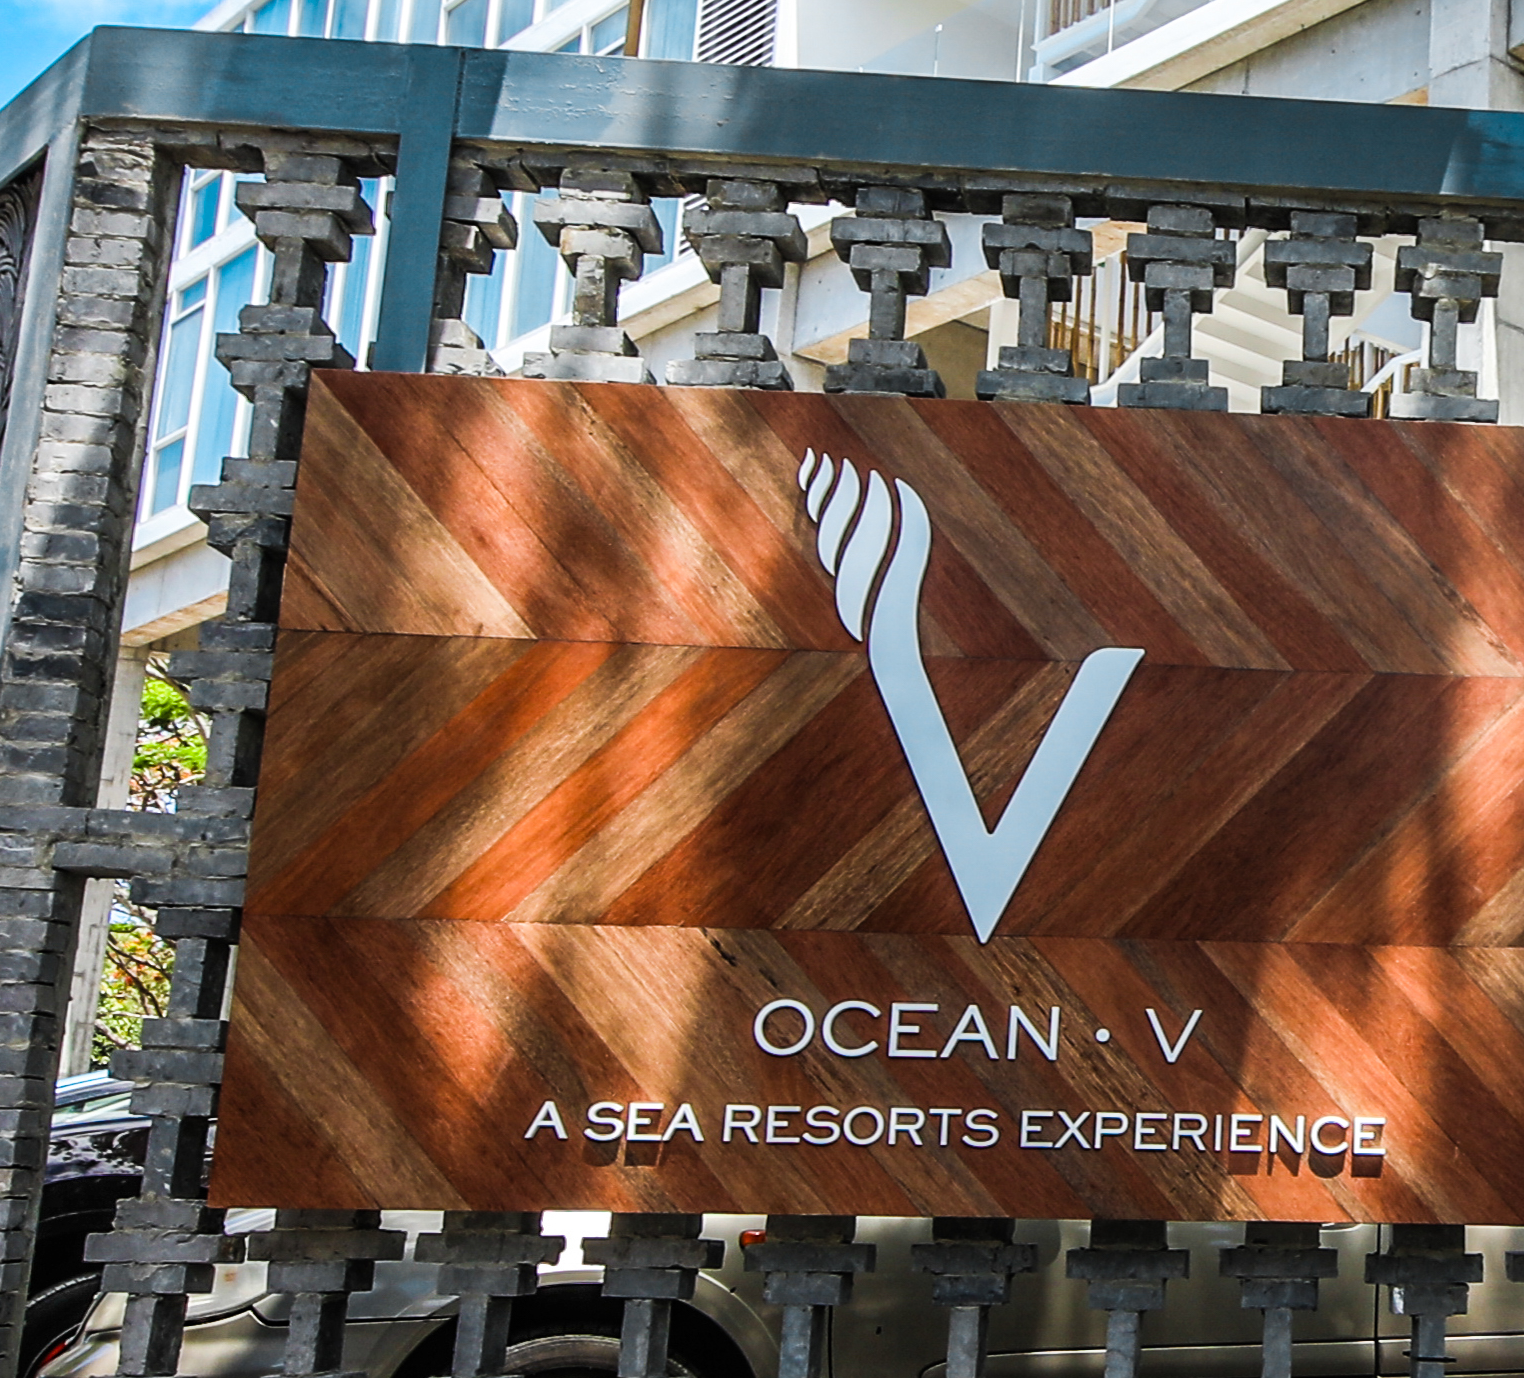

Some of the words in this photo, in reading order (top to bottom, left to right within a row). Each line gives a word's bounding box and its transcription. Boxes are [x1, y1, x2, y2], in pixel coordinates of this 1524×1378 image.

[753, 998, 1062, 1062] OCEAN
[1143, 1007, 1204, 1065] V
[523, 1100, 569, 1140] A
[583, 1101, 706, 1143] SEA
[722, 1104, 1000, 1149] RESORTS
[1019, 1109, 1388, 1157] EXPERIENCE
